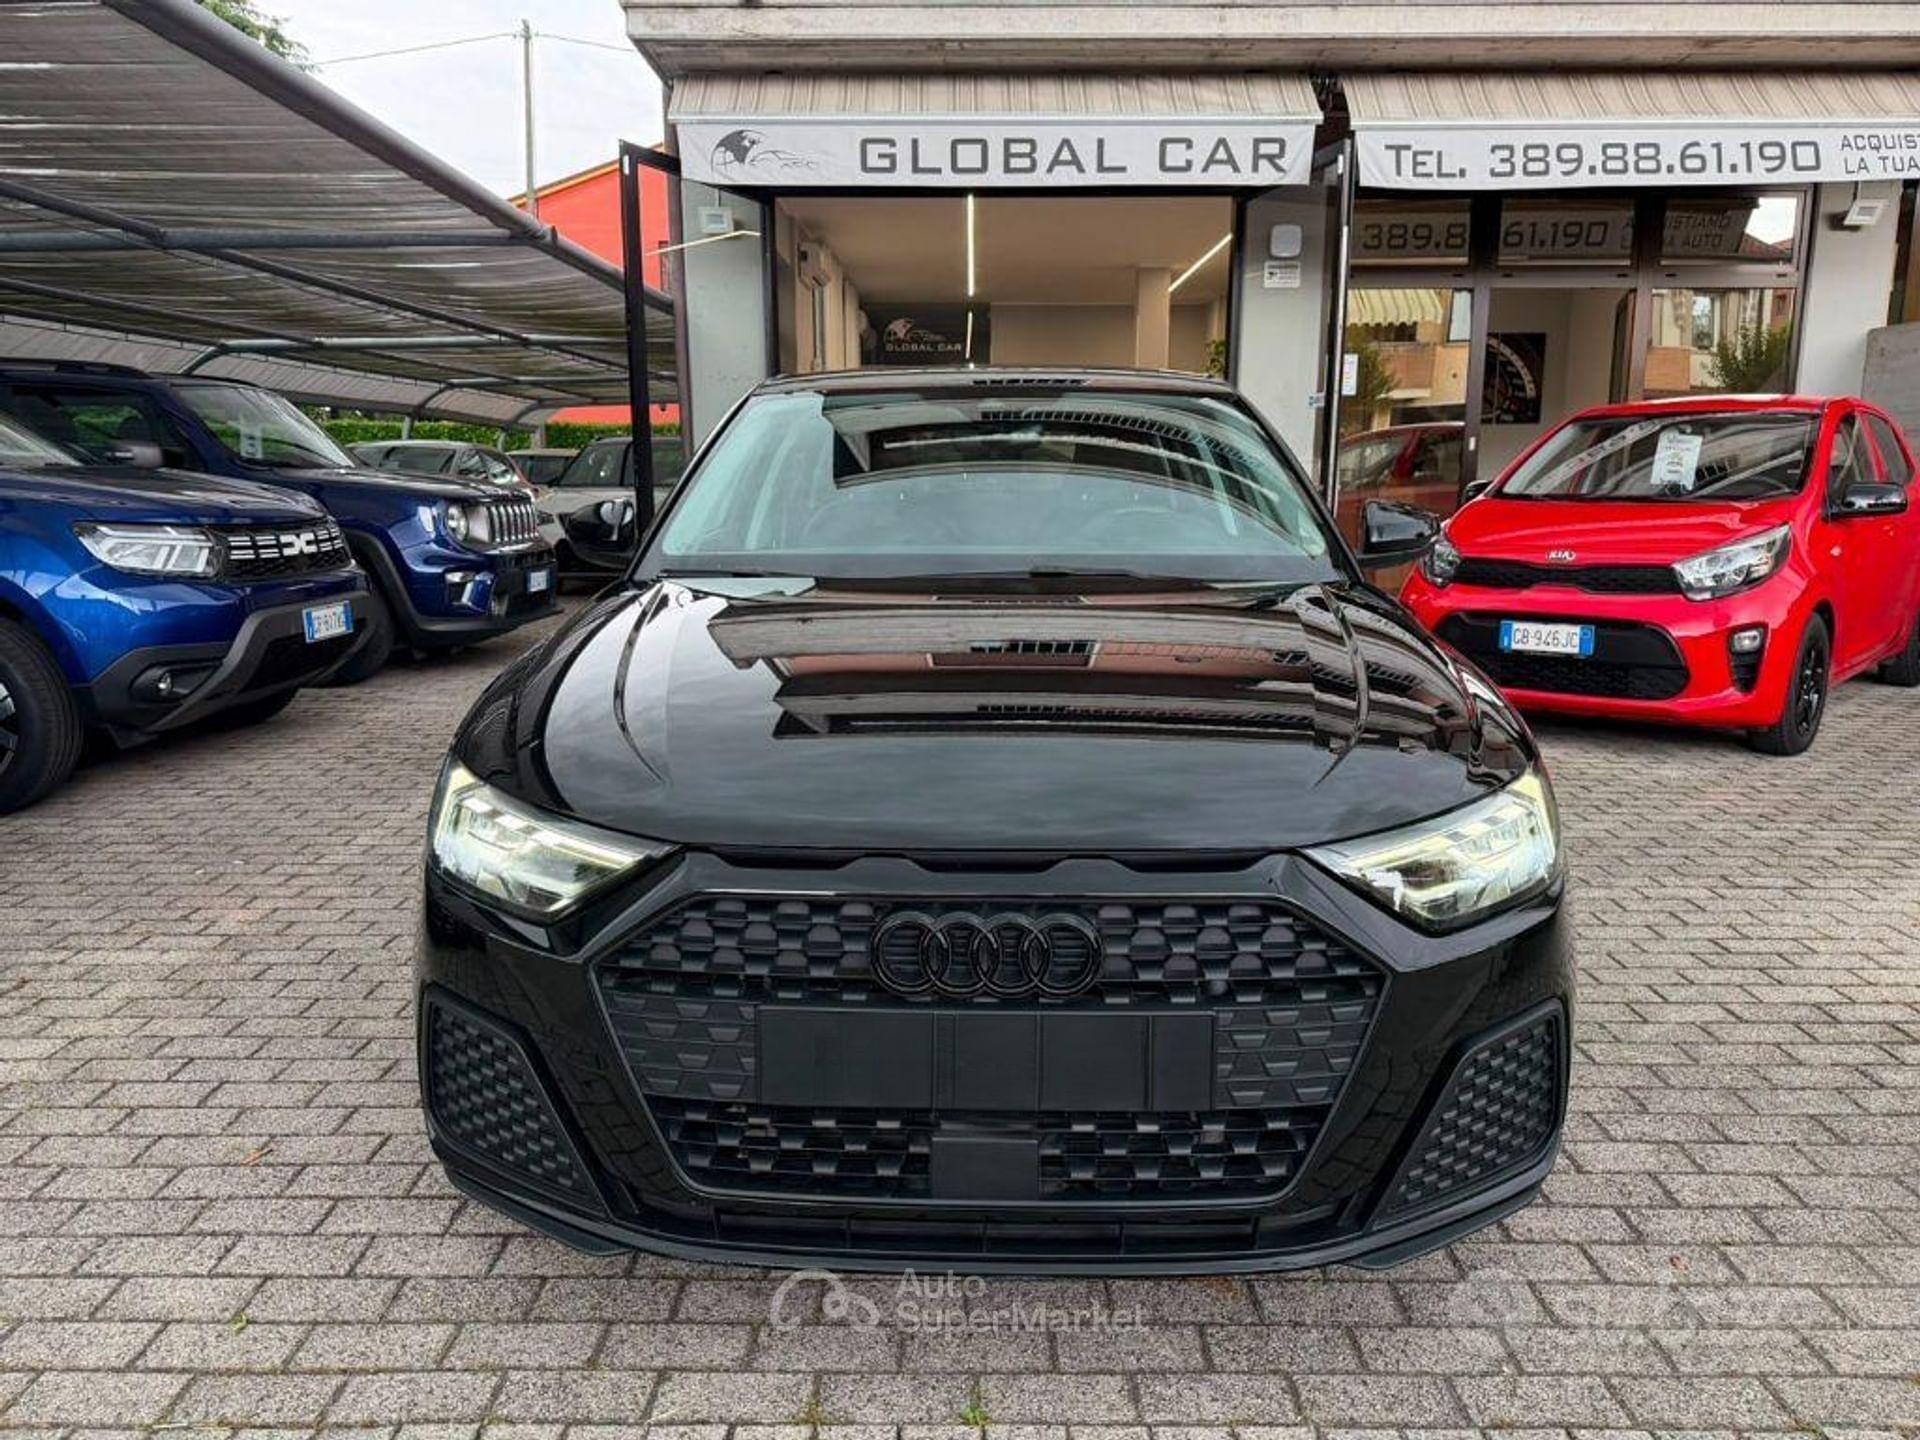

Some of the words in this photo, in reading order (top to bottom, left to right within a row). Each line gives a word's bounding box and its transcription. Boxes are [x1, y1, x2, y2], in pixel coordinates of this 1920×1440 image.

[1841, 134, 1920, 153] ACQUIS
[860, 137, 1127, 174] GLOBAL
[1158, 137, 1287, 173] CAR
[1489, 140, 1822, 178] 389.88.61.190
[1844, 156, 1870, 175] LA
[1878, 155, 1920, 173] TUA
[885, 342, 934, 352] GLOBAL
[937, 342, 962, 352] CAR
